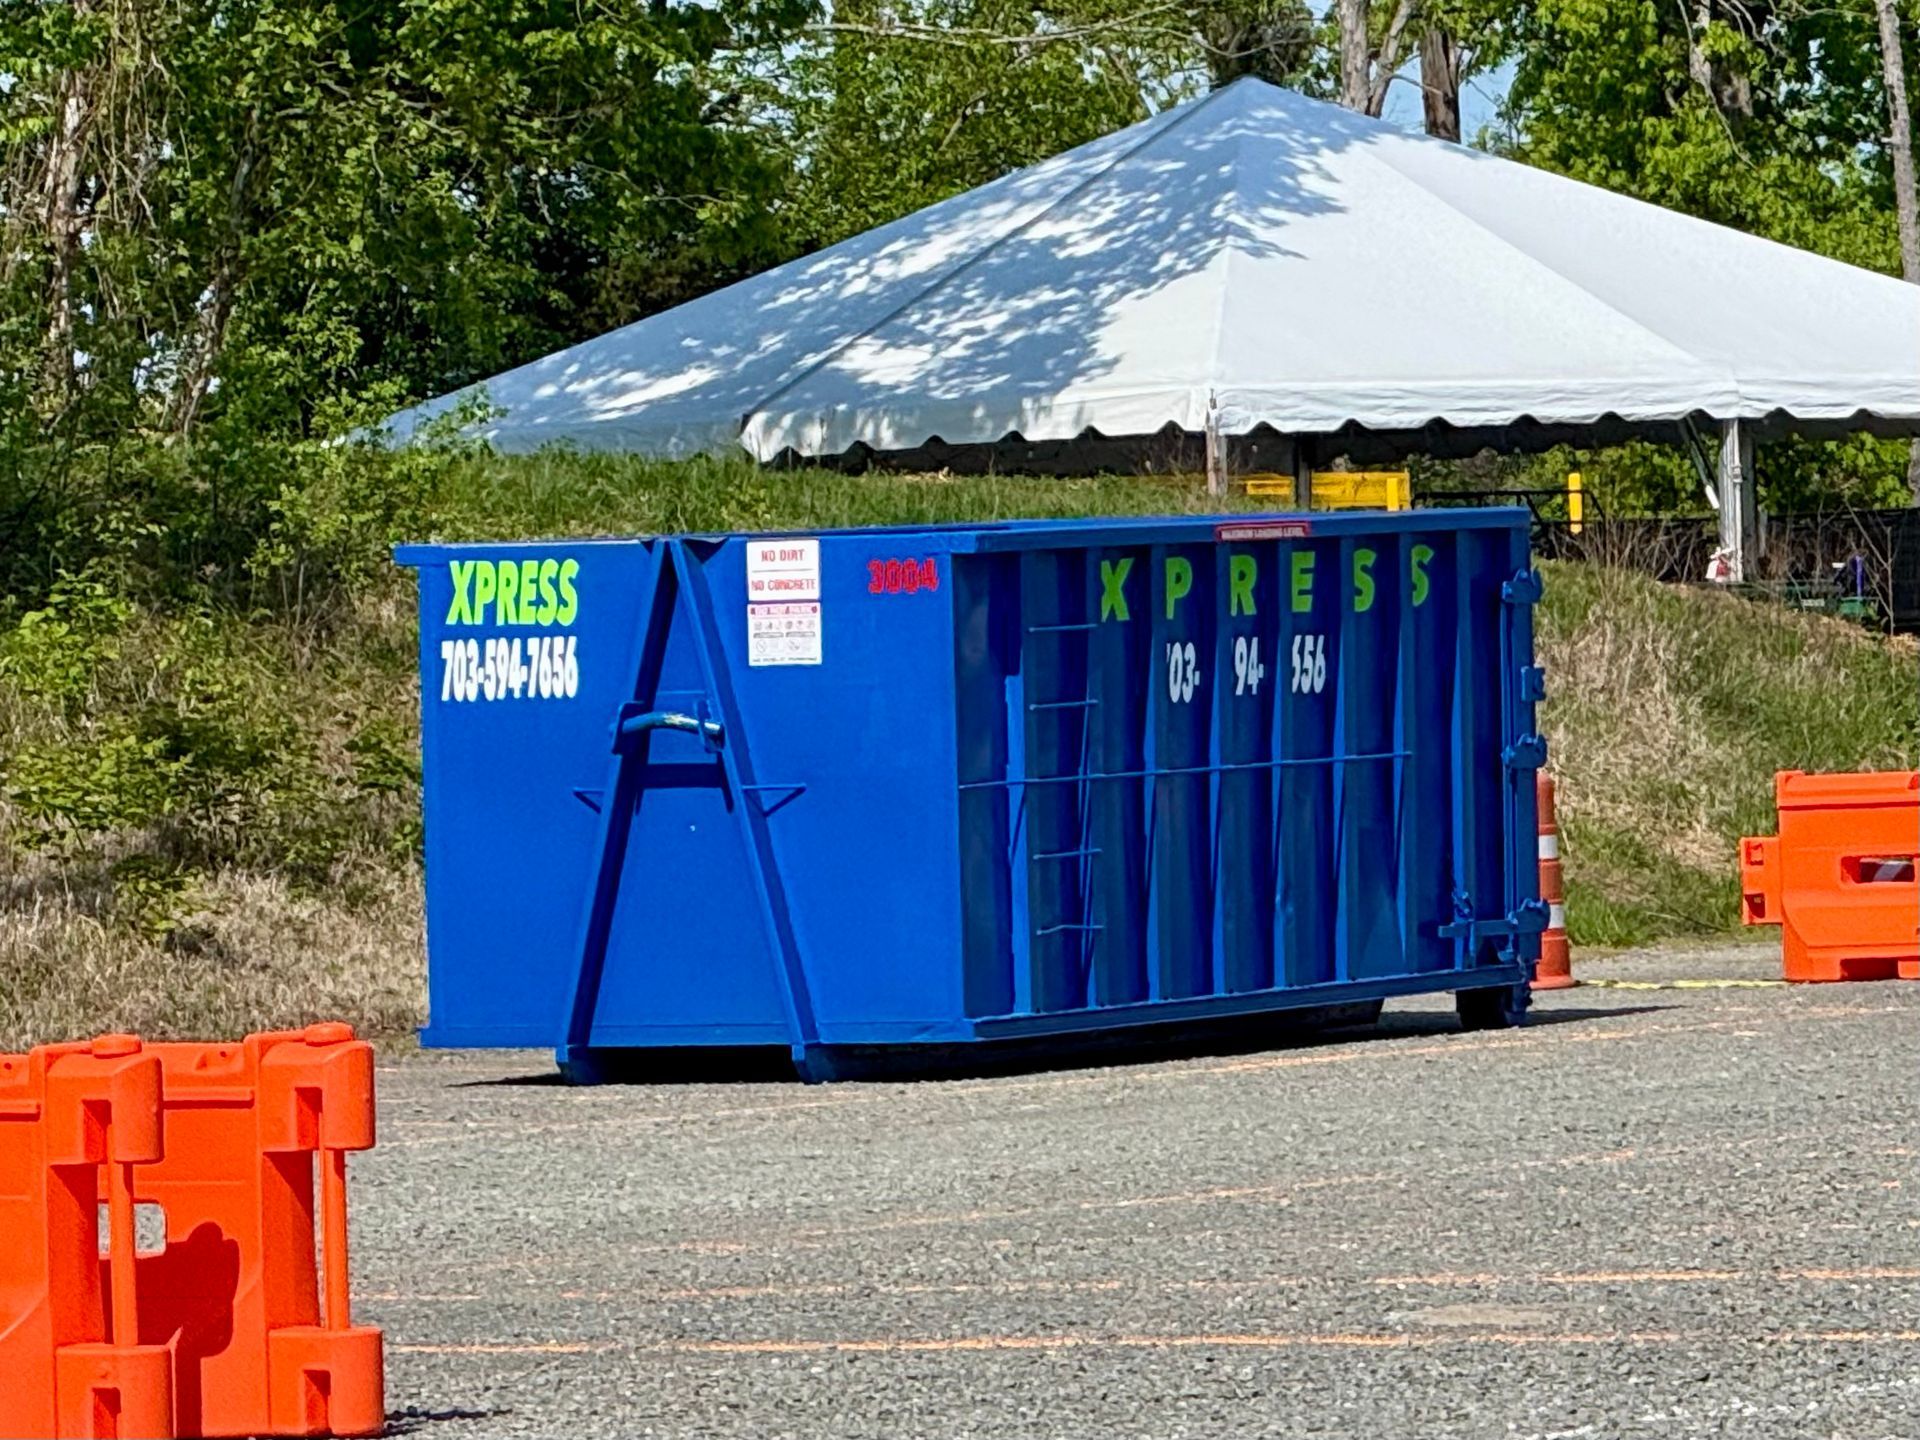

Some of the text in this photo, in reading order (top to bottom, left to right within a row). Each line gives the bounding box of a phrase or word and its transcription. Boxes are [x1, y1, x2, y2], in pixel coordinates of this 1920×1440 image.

[761, 548, 805, 562] NO DIRT
[867, 557, 938, 594] 3004
[445, 558, 580, 627] XPRESS
[751, 578, 816, 591] NO CONCRETE
[1101, 544, 1434, 622] XPRESS
[441, 636, 579, 702] 703-594-7656
